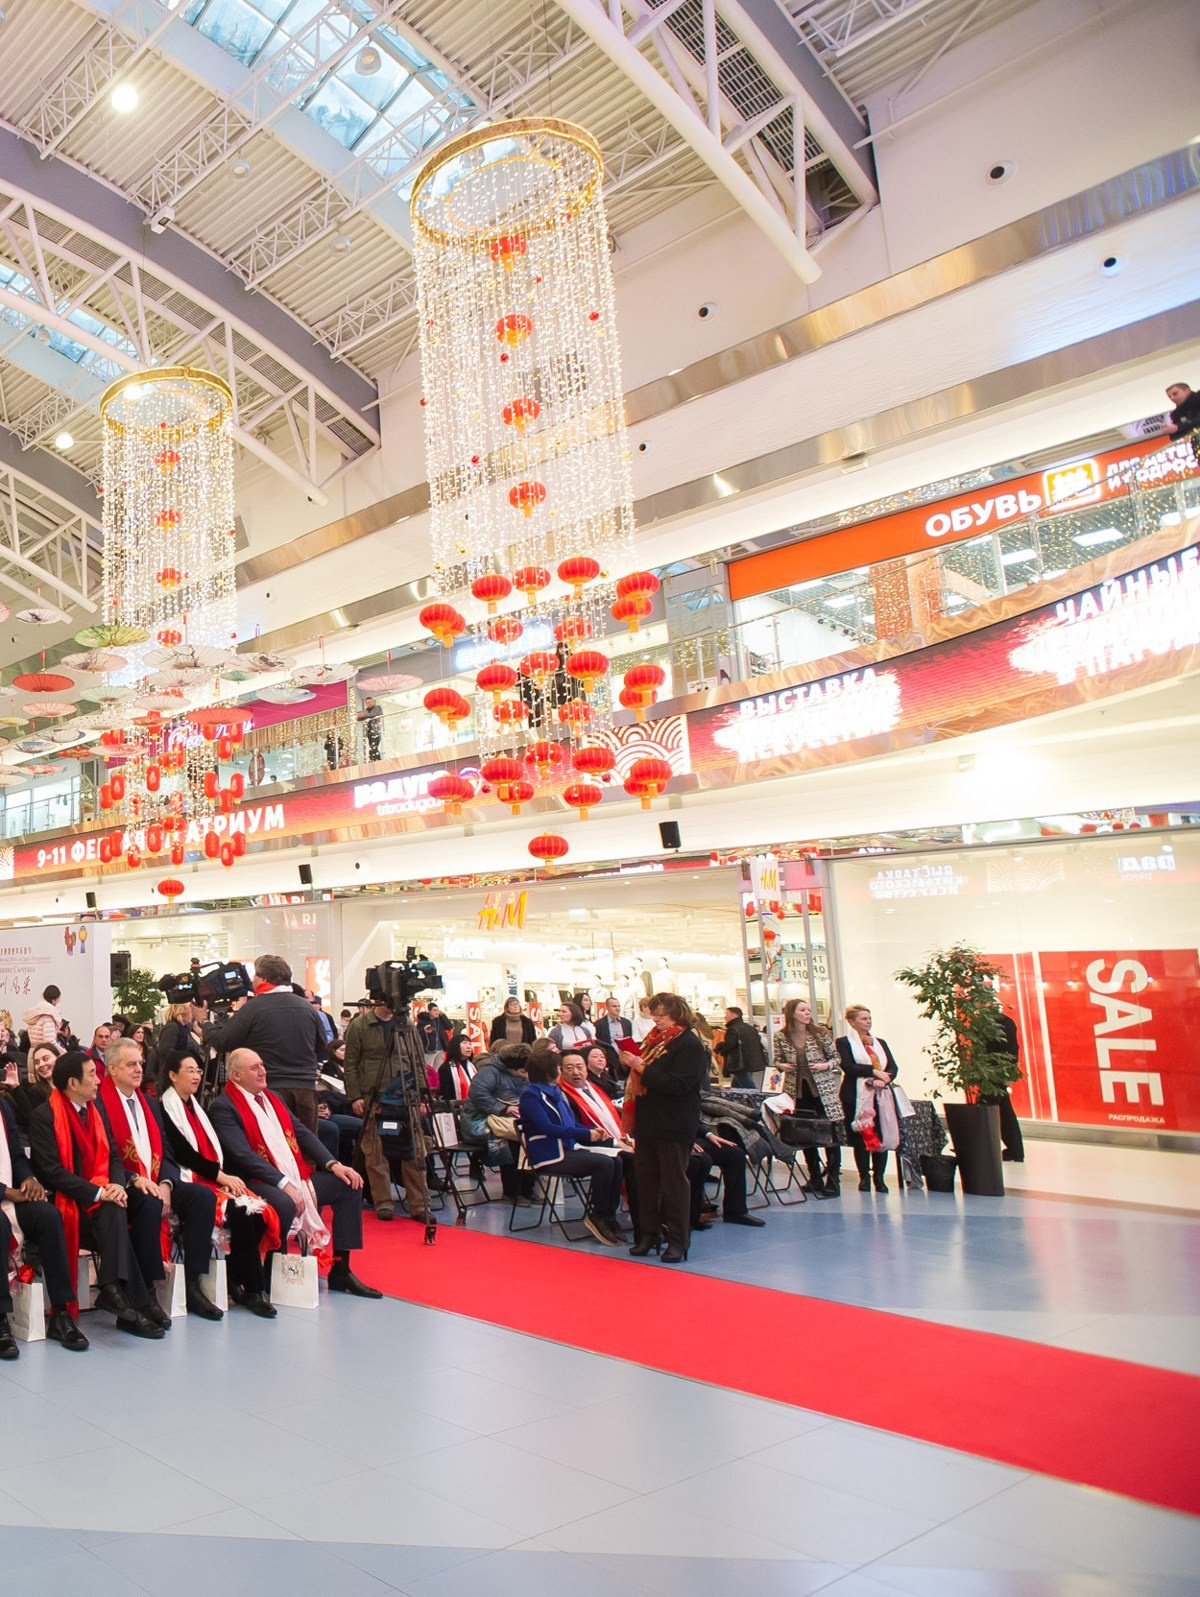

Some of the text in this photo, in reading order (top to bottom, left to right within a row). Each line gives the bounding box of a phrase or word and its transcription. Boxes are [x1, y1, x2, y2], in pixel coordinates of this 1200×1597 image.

[925, 489, 1042, 537] ОБУВЬ
[1056, 547, 1199, 624] ЧАЙНЫЕ
[740, 668, 878, 720] ВЫСТАВКА
[354, 770, 449, 808] радуг
[37, 845, 67, 868] 9-11
[185, 804, 285, 844] АТРИУМ
[760, 867, 777, 891] H&M
[477, 889, 528, 930] H&M
[469, 1007, 481, 1048] SAL
[1085, 958, 1165, 1106] SALE
[1108, 1113, 1166, 1124] РАСПРОДАЖА
